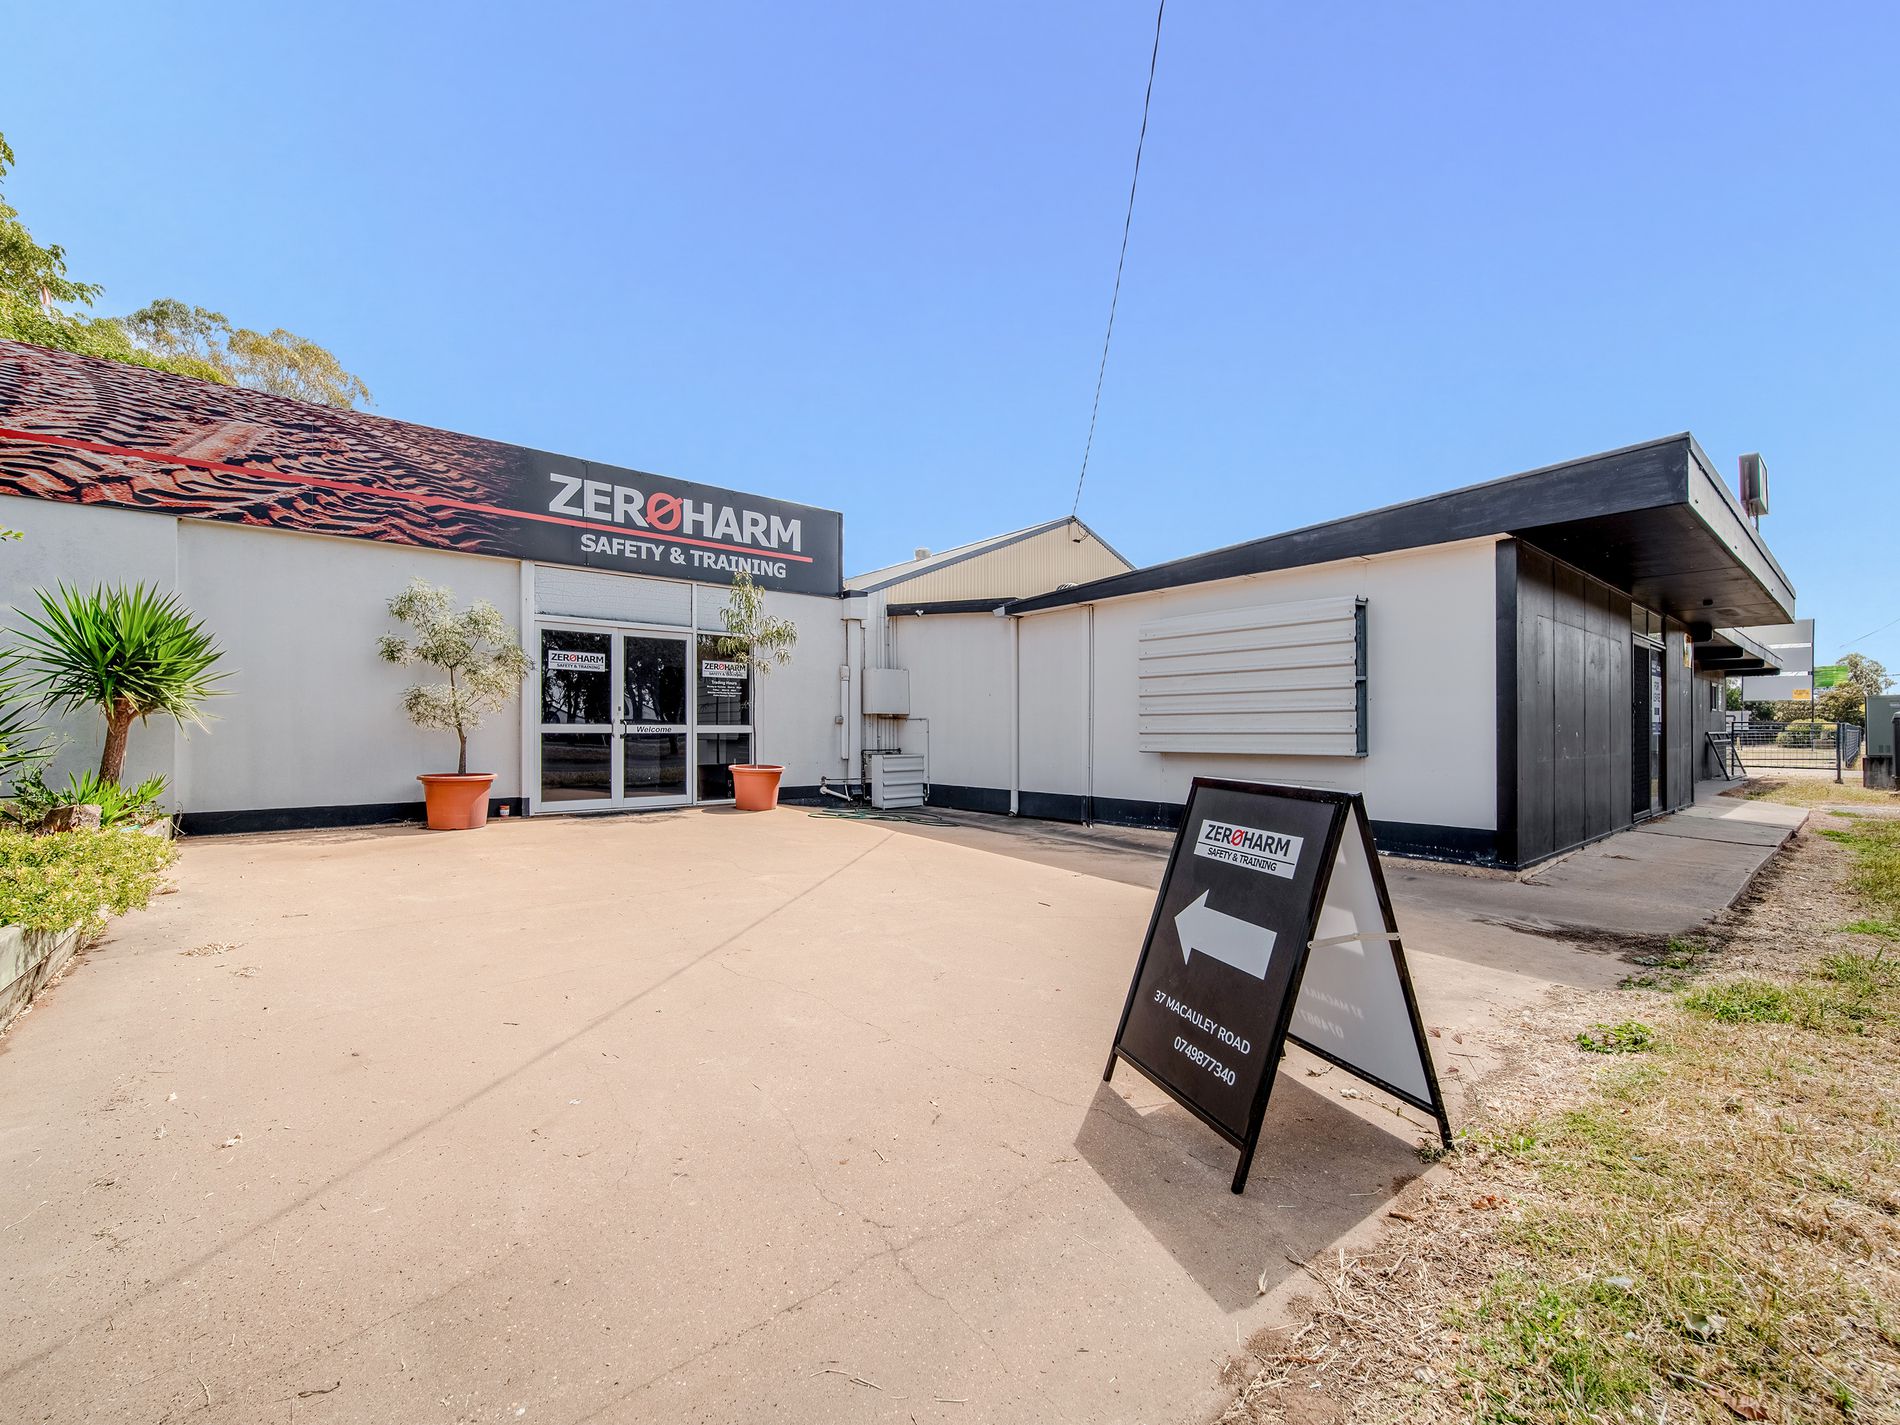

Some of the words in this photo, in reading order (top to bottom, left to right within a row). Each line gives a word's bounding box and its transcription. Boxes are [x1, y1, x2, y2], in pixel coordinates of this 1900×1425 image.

[580, 534, 665, 561] SAFETY
[669, 547, 687, 565] &
[690, 550, 786, 578] TRAINING
[1207, 847, 1232, 860] SAFETY
[1232, 853, 1238, 862] &
[1240, 855, 1277, 871] TRAINING
[1154, 990, 1166, 1003] 37
[1166, 996, 1218, 1035] MACAULEY
[1217, 1026, 1251, 1054] ROAD
[1173, 1036, 1236, 1086] 0749877340
